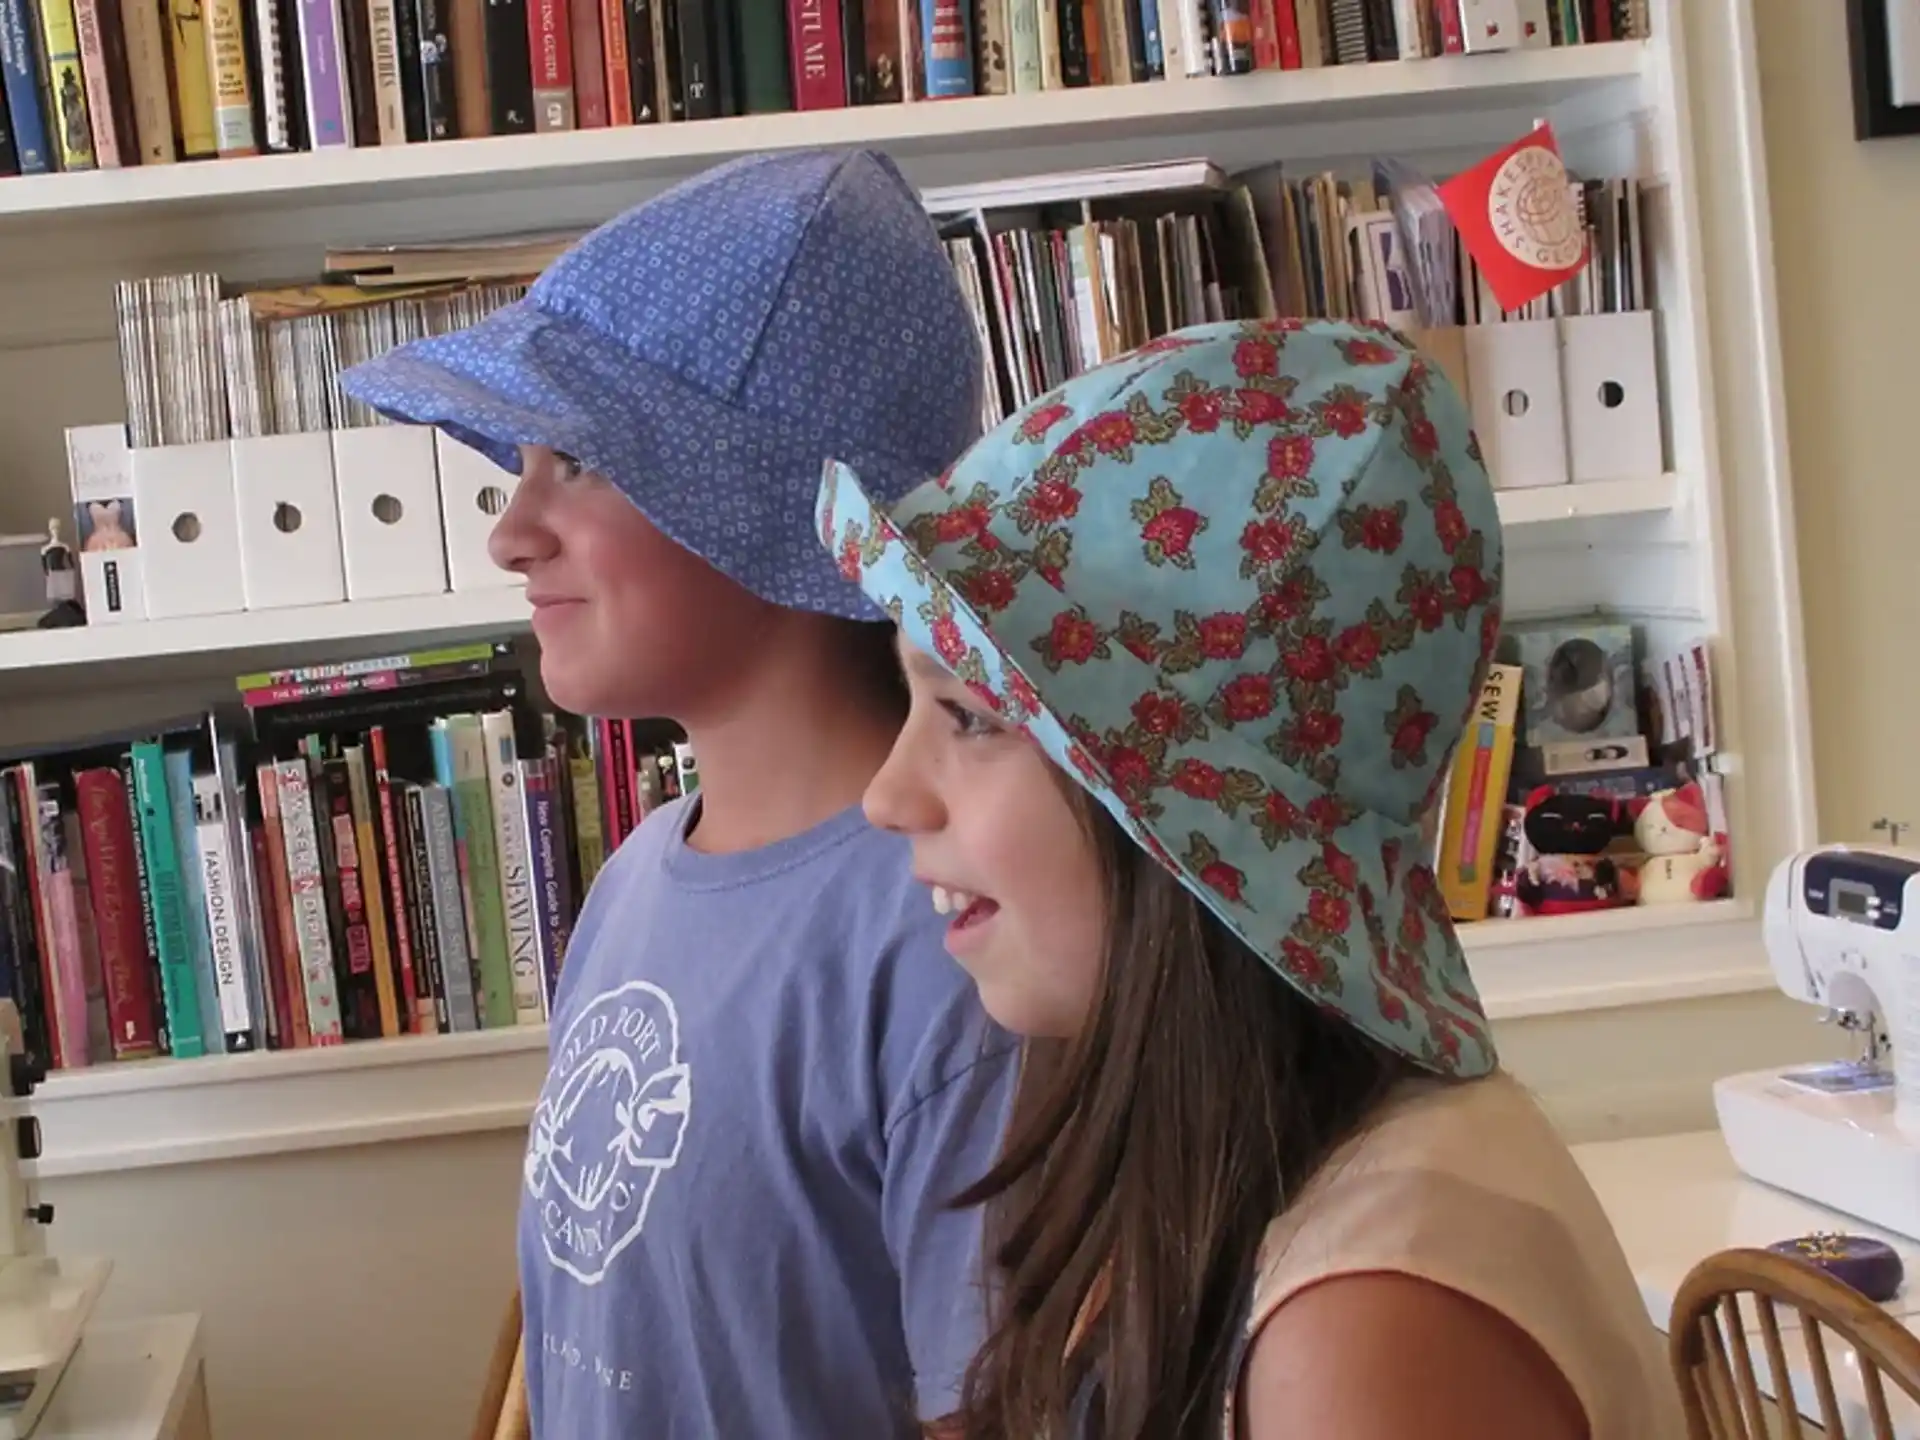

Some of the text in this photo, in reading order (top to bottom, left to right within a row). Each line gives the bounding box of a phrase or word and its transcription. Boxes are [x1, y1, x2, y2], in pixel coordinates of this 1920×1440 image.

[1480, 670, 1504, 721] SEW
[285, 767, 304, 812] SEW
[536, 800, 549, 827] New
[540, 828, 556, 880] Complete
[205, 850, 234, 985] FASHION DESIGN
[507, 866, 536, 977] SEWING
[546, 881, 560, 913] Guide
[549, 914, 560, 927] to
[560, 1006, 661, 1077] OLD PORT
